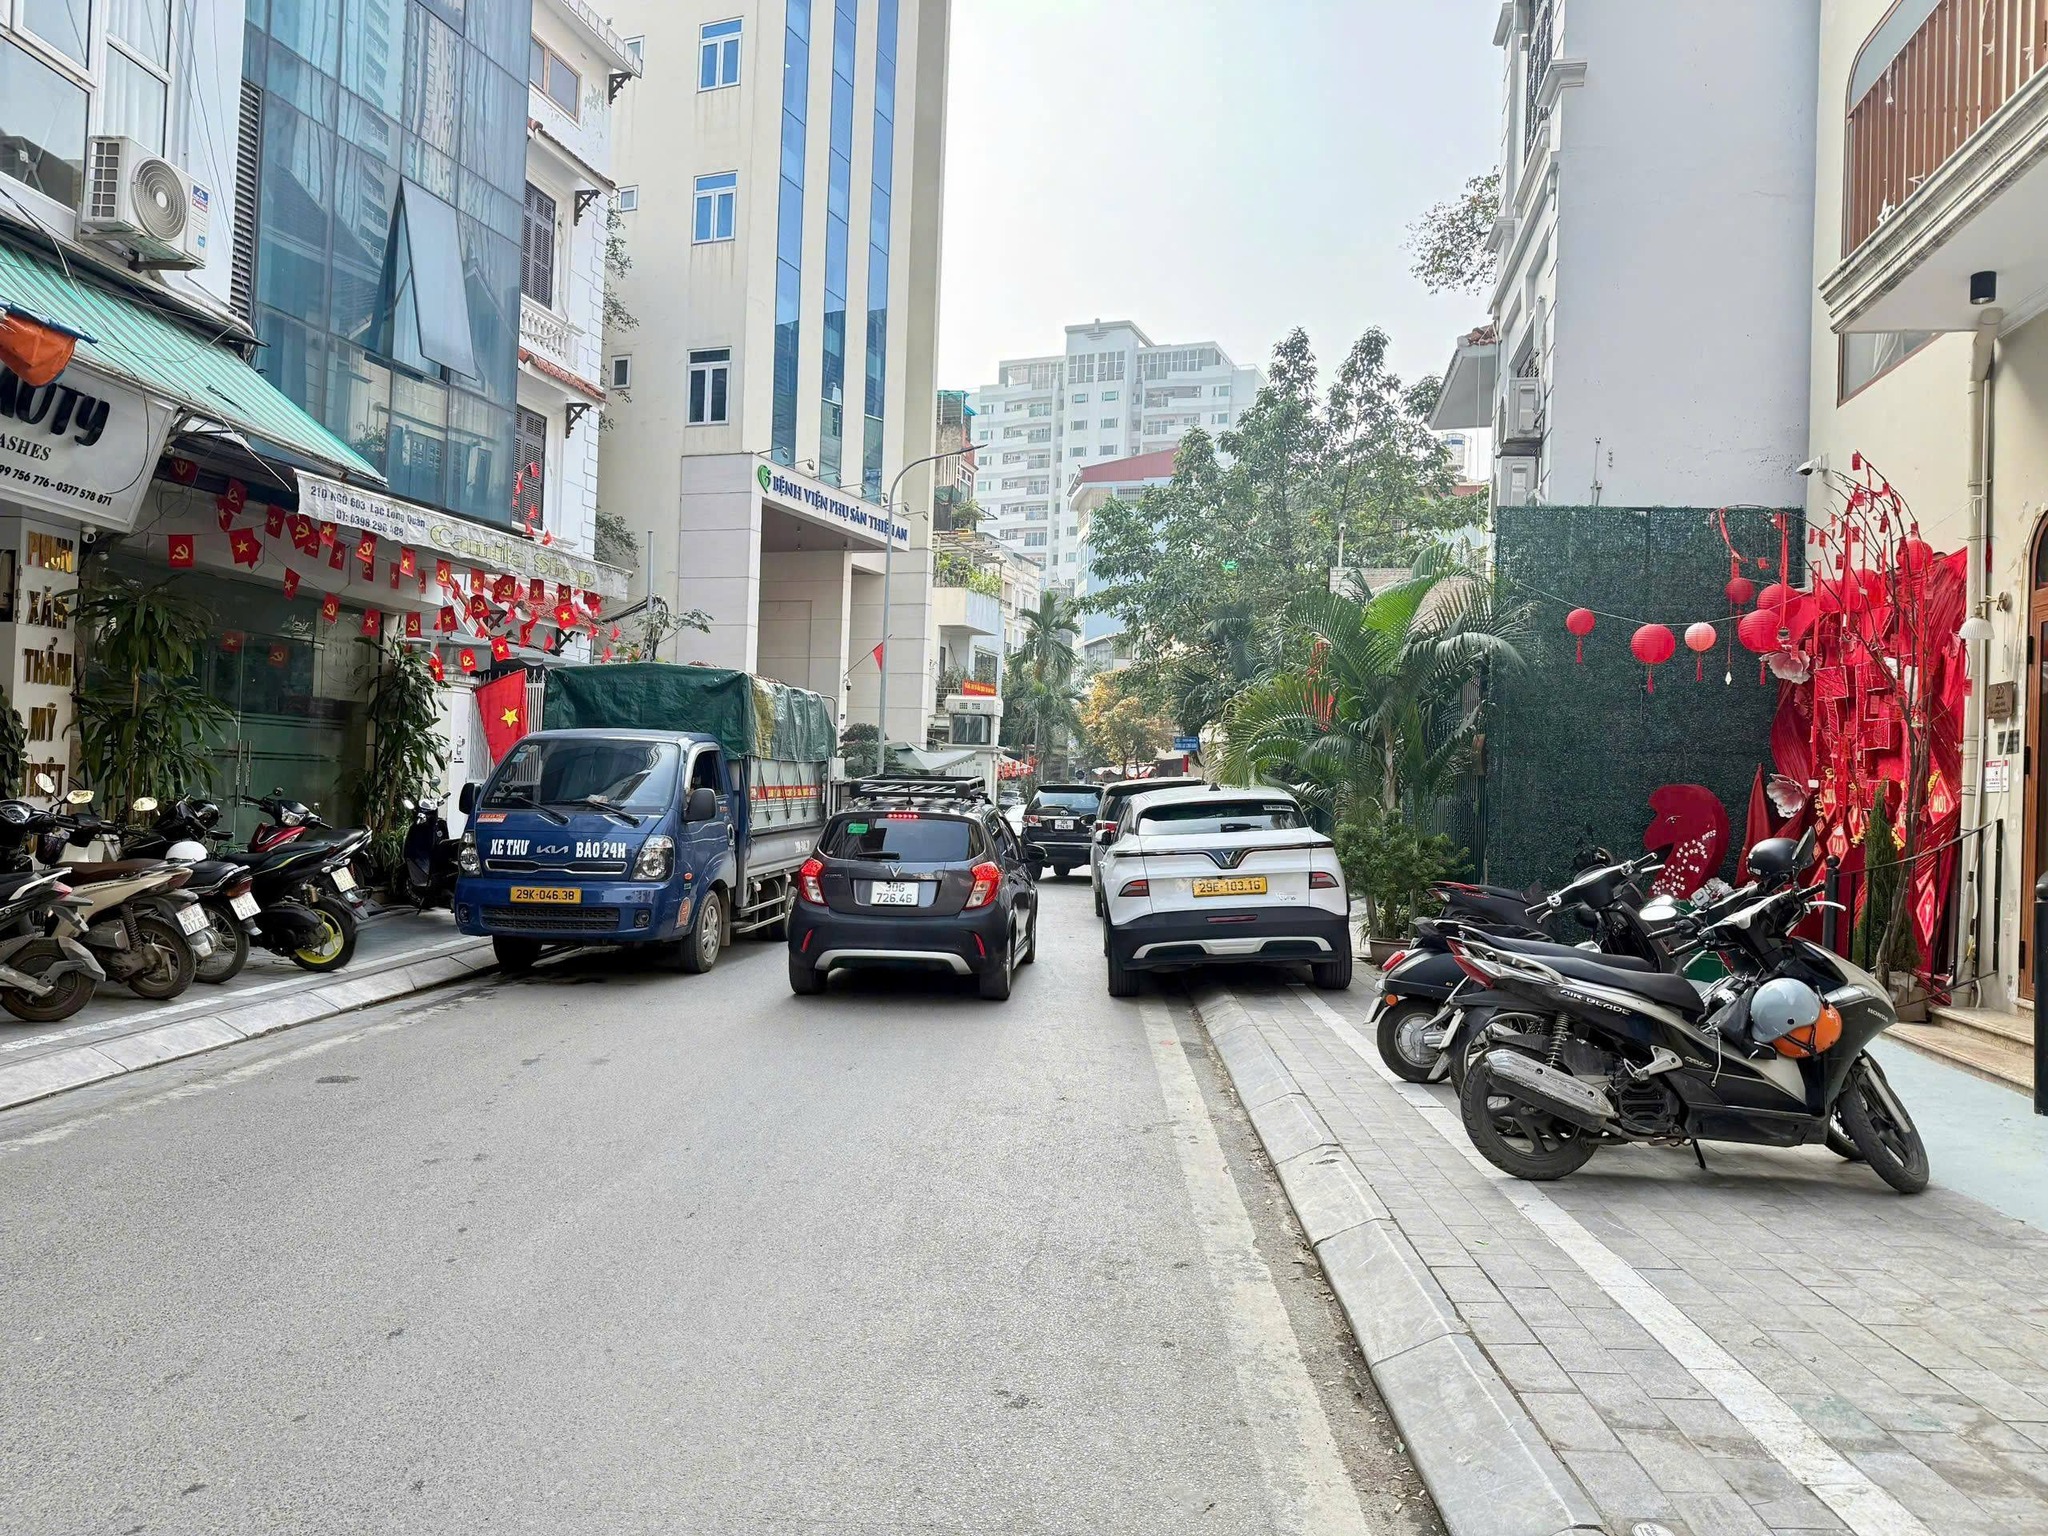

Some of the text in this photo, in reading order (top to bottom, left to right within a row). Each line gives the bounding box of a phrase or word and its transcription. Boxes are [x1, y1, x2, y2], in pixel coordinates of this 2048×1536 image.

[0, 433, 52, 461] ASHES
[12, 469, 31, 482] 756
[79, 488, 96, 501] 578
[97, 494, 112, 506] 871
[350, 497, 366, 510] 603
[370, 504, 385, 516] Lạc
[387, 506, 405, 523] Long
[773, 475, 802, 500] BỆNH
[804, 490, 828, 511] VIỆN
[829, 498, 849, 521] PHỤ
[850, 506, 868, 526] SẢN
[895, 528, 907, 541] AN
[430, 525, 595, 588] Camila Shop
[490, 839, 530, 856] XE THƯ
[575, 838, 627, 858] BÁO 24H
[876, 893, 913, 904] 726.46
[886, 881, 905, 893] 30G
[1560, 989, 1632, 1016] AIR BLADE
[1867, 1007, 1889, 1023] HONDA
